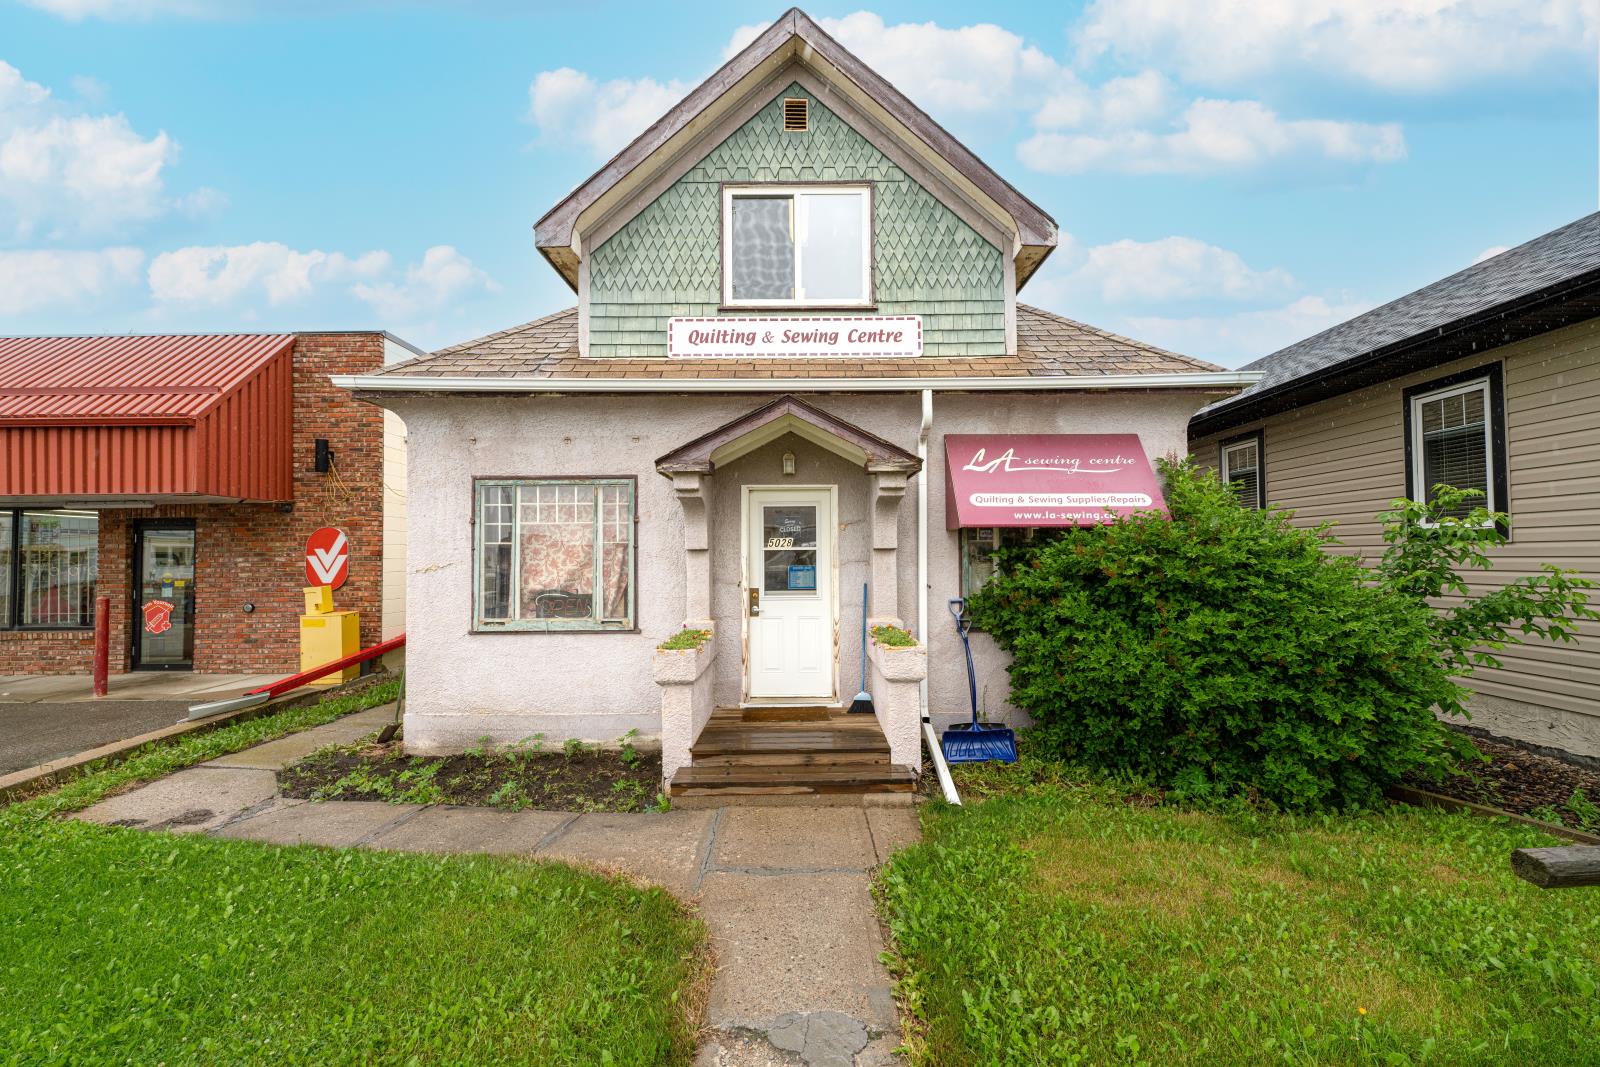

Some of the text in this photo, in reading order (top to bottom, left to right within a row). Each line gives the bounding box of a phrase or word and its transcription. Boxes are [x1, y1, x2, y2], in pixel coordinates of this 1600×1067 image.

[688, 328, 903, 346] Quilting & Sewing Centre
[962, 447, 1137, 475] LA sewing centre
[975, 495, 1147, 505] Quilting & Sewing Supplies/Repairs
[779, 525, 801, 533] CLOSED
[768, 538, 793, 548] 5028
